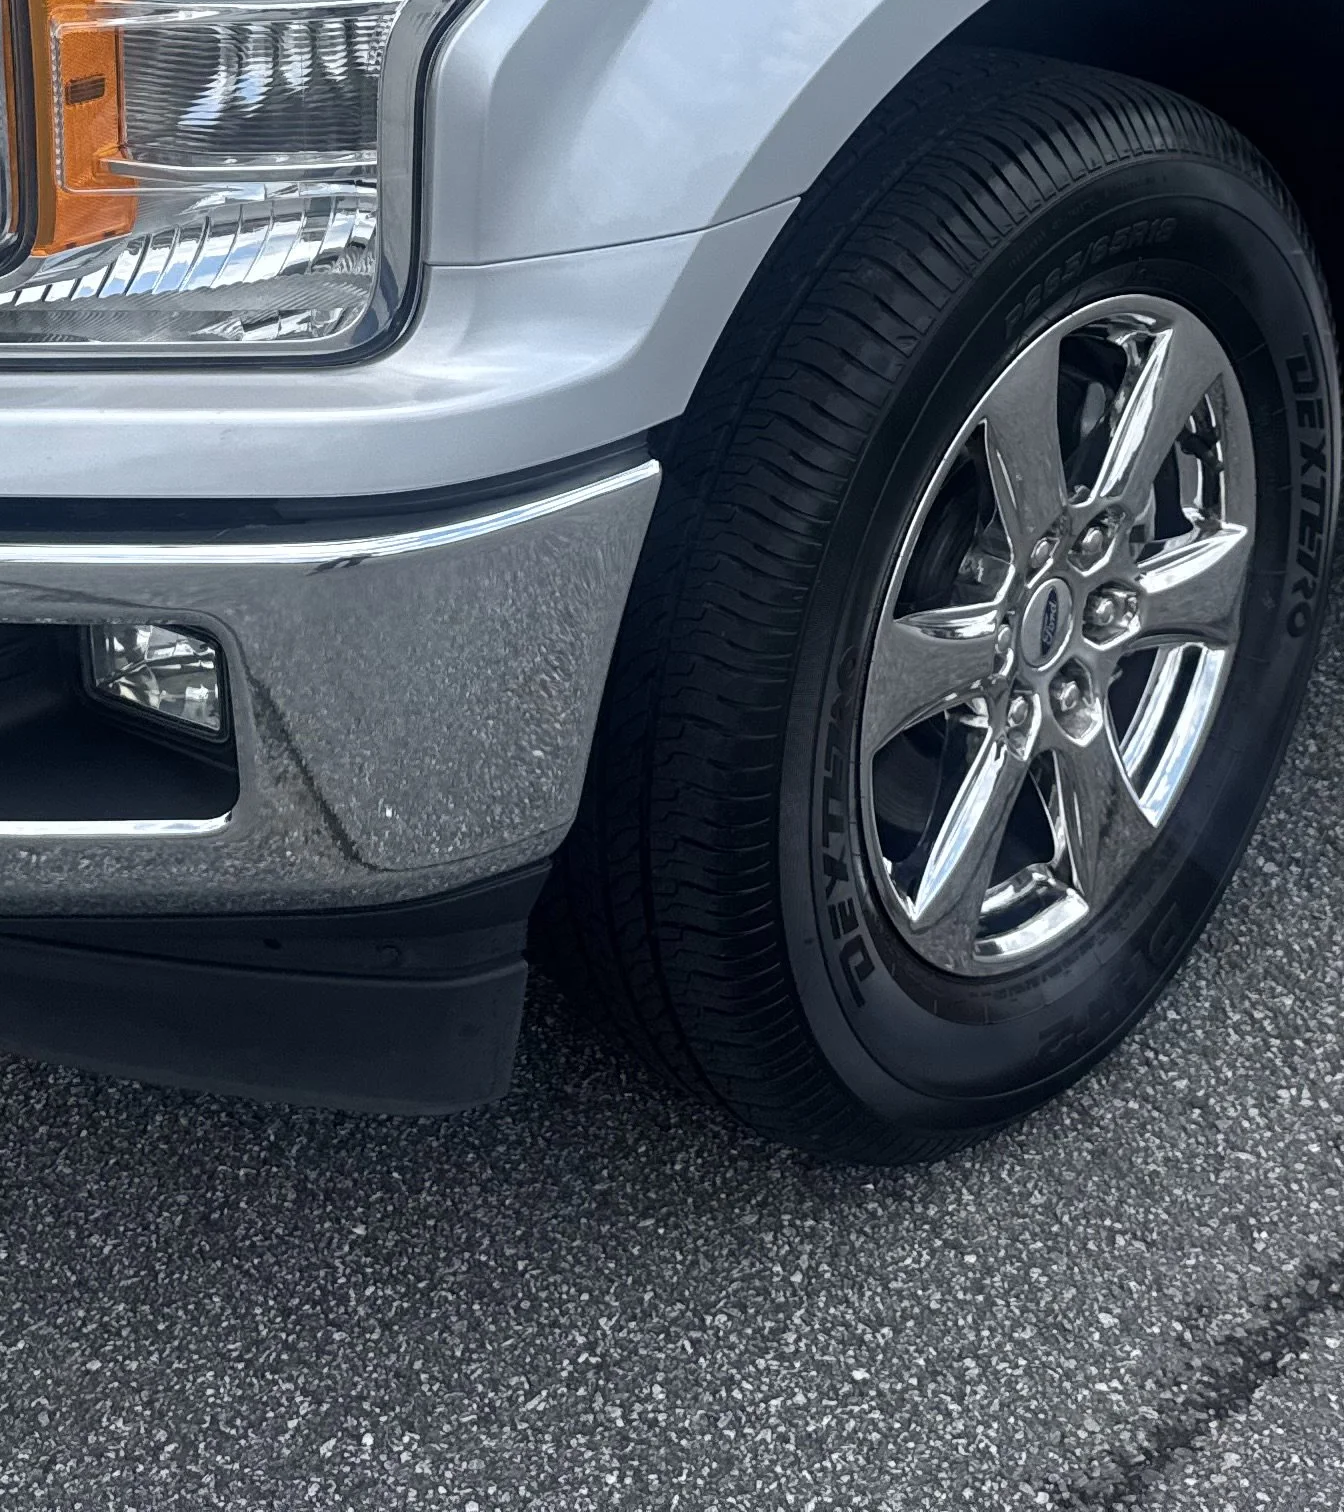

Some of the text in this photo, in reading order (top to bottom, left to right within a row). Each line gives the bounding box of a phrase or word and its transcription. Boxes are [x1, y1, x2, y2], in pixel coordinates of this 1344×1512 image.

[1042, 600, 1057, 646] Ford
[1285, 332, 1328, 638] DEXTERO
[822, 644, 875, 1008] DEXTERO
